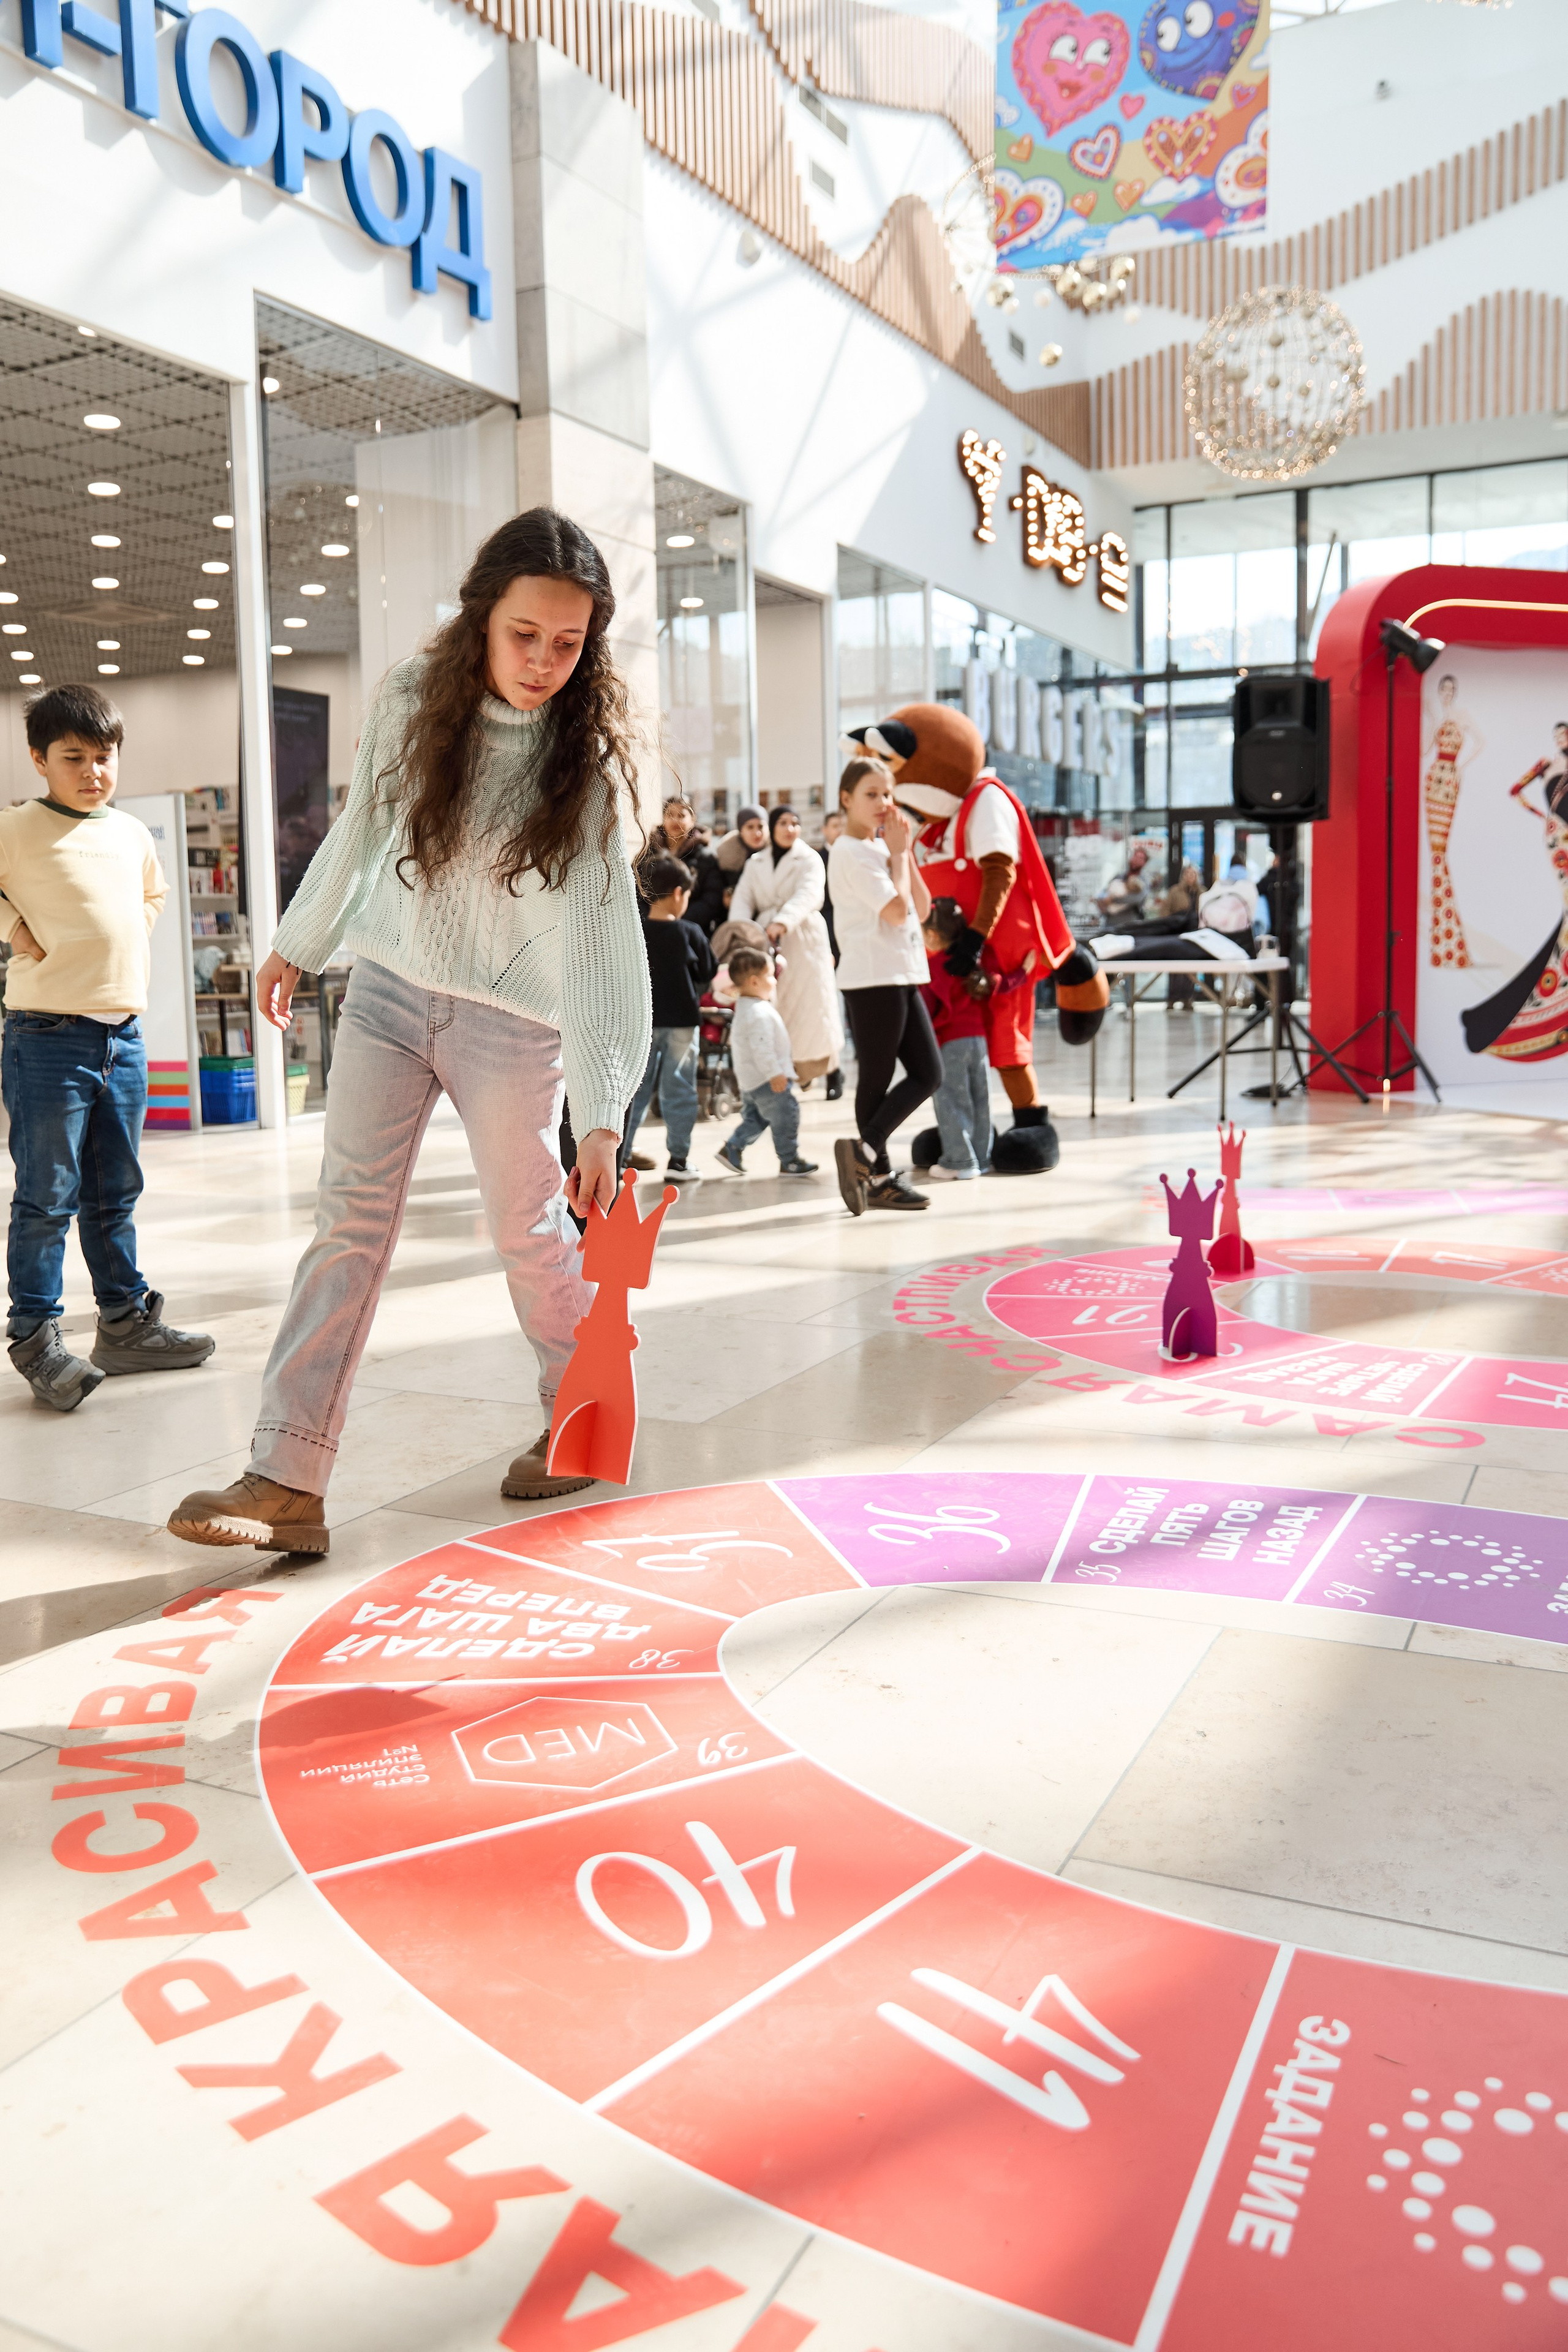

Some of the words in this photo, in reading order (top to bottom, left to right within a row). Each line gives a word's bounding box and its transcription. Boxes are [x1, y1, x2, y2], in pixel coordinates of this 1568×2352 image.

[0, 0, 492, 322] -ГОРОД
[963, 658, 1121, 777] BURGERS
[892, 1246, 1063, 1371] СЧАСТЛИВАЯ
[1072, 1303, 1157, 1325] 21
[1232, 1355, 1340, 1384] НАЗАД
[1283, 1361, 1363, 1387] ШАГА
[1361, 1362, 1430, 1403] СДЕЛАЙ
[1042, 1373, 1486, 1449] САМАЯ
[864, 1501, 1012, 1555] 36
[1090, 1485, 1170, 1555] СДЕЛАЙ
[1148, 1502, 1210, 1548] ПЯТЬ
[1196, 1498, 1264, 1562] ШАГОВ
[1251, 1504, 1323, 1566] НАЗАД
[582, 1528, 794, 1573] 37
[1074, 1559, 1123, 1584] 35
[350, 1601, 514, 1632] ШАГА
[414, 1573, 633, 1622] ВПЕРЕД
[1323, 1580, 1376, 1608] 34
[319, 1633, 597, 1664] СДЕЛАЙ
[527, 1615, 651, 1642] ДВА
[628, 1648, 695, 1670] 38
[299, 1753, 423, 1780] эпиляции
[696, 1730, 749, 1767] 39
[341, 1762, 426, 1786] студий
[373, 1773, 431, 1789] Сеть
[51, 1586, 404, 2142] КРАСИВАЯ
[575, 1820, 797, 1961] 40
[875, 1967, 1143, 2130] 41
[1226, 2013, 1352, 2258] ЗАДАНИЕ
